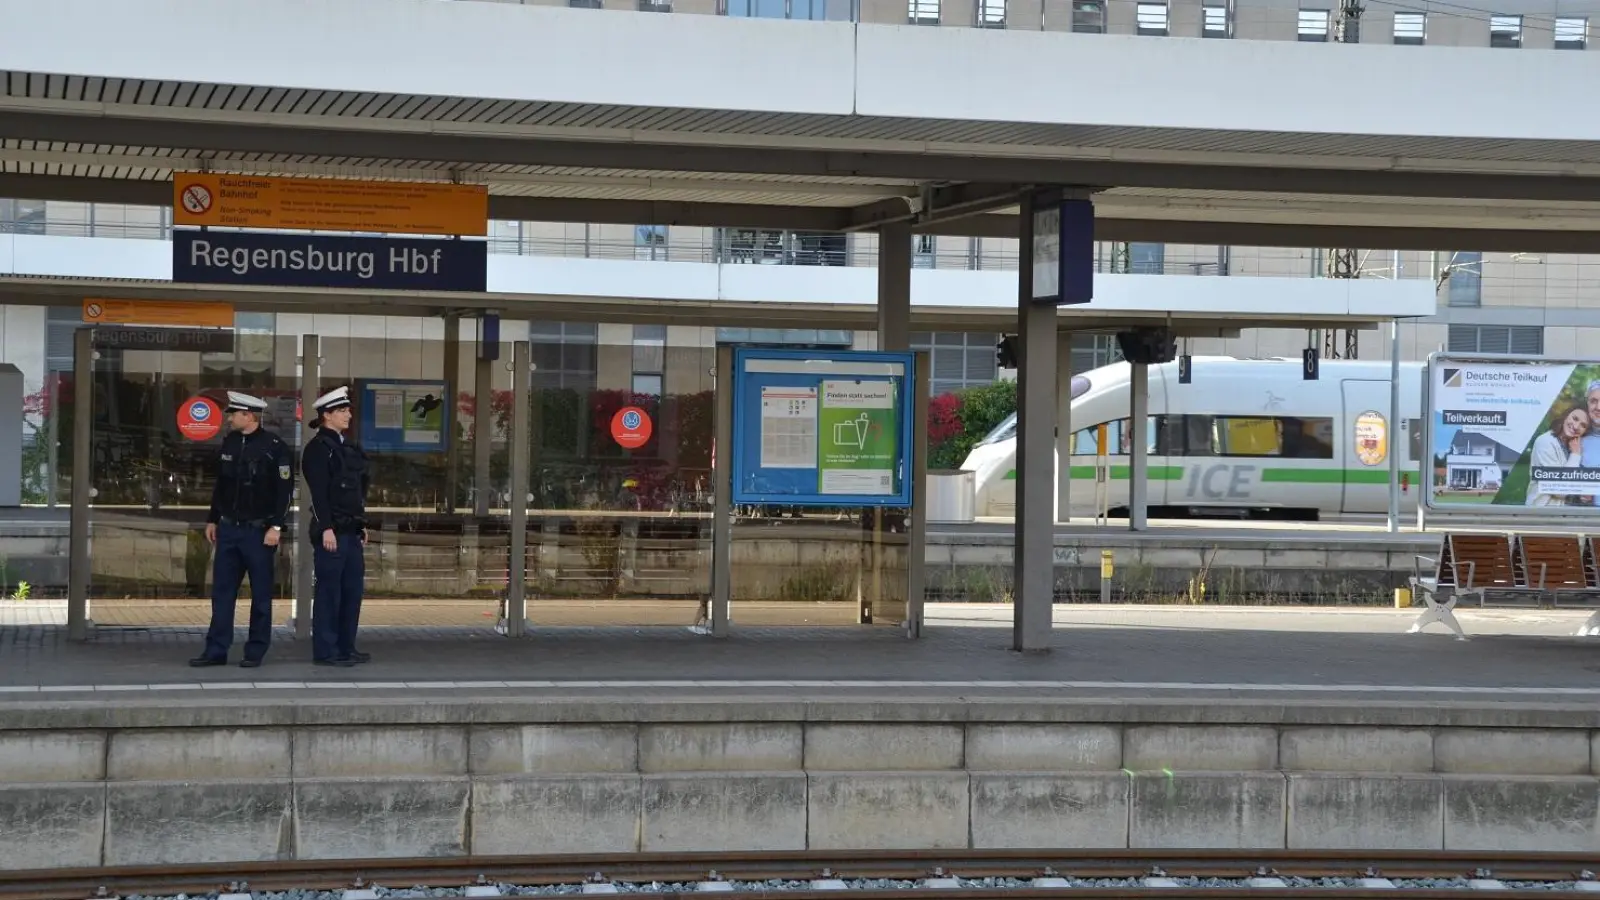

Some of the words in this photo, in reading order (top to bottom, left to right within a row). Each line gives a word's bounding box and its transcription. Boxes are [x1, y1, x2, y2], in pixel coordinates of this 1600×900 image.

[219, 177, 272, 189] Rauchfreier
[219, 189, 258, 199] Bahnhof
[219, 205, 272, 216] Non-Smoking
[219, 215, 248, 224] Station
[190, 239, 375, 279] Regensburg
[388, 247, 442, 275] Hbf
[91, 329, 180, 346] Regensburg
[1179, 356, 1186, 378] 9
[1306, 350, 1314, 373] 8
[1466, 371, 1511, 381] Deutsche
[1513, 372, 1548, 383] Teilkauf
[1445, 412, 1505, 424] Teilverkauft.
[1534, 469, 1560, 479] Ganz
[1185, 464, 1256, 498] ICE
